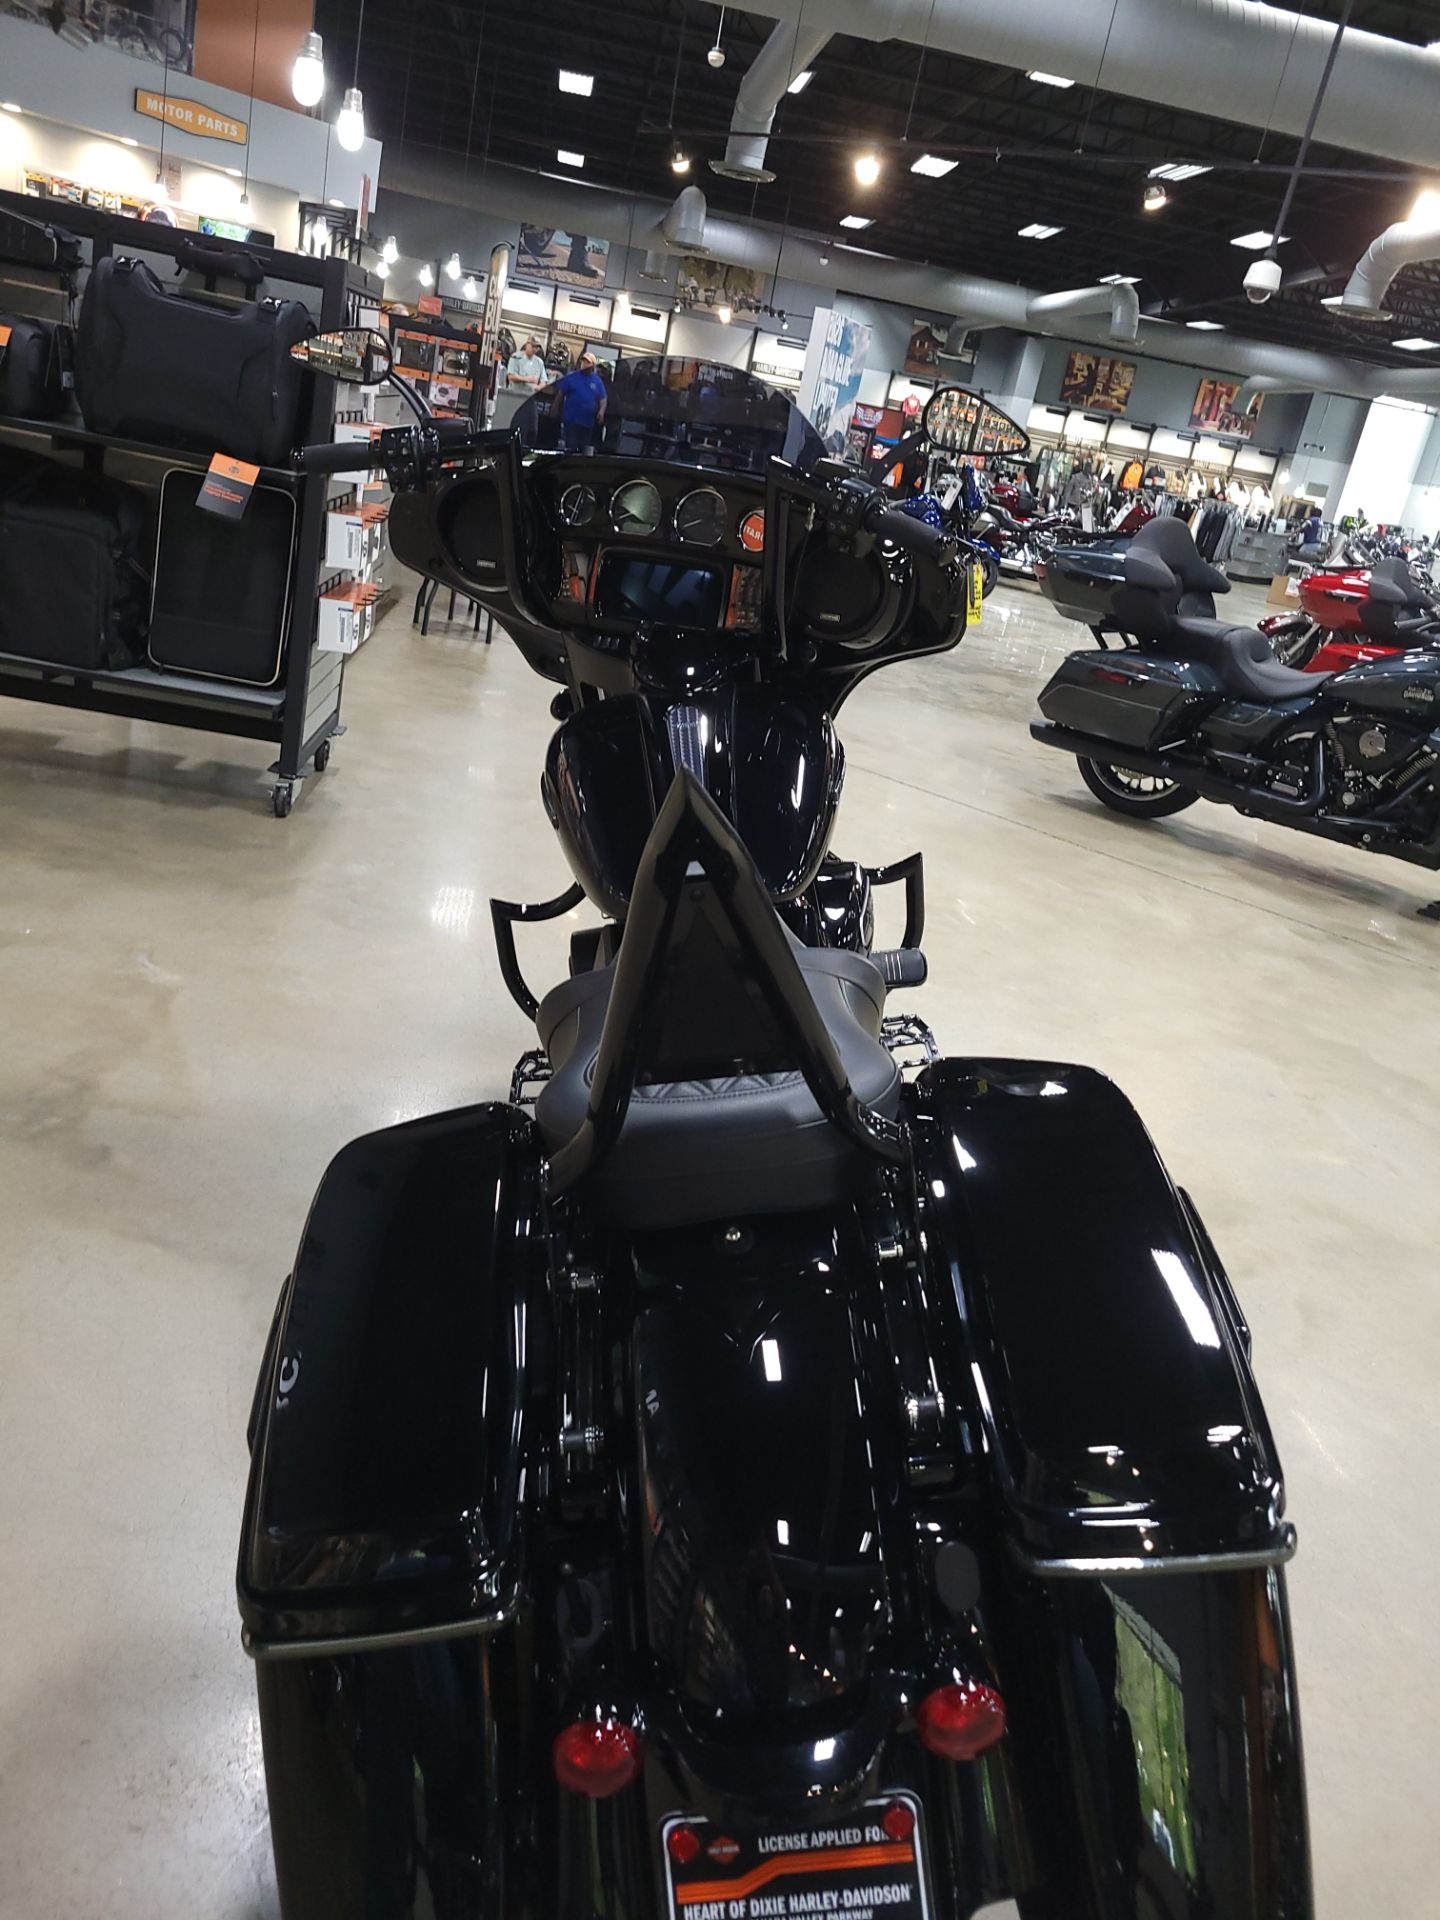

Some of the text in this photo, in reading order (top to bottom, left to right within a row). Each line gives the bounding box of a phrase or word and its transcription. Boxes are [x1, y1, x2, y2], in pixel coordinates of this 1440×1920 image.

[146, 98, 238, 137] MOTOR PARTS
[758, 1832, 809, 1854] LICENSE
[811, 1828, 862, 1848] APPLIED
[684, 1884, 911, 1920] HEART OF DIXIE HARLEY-DAVIDSON
